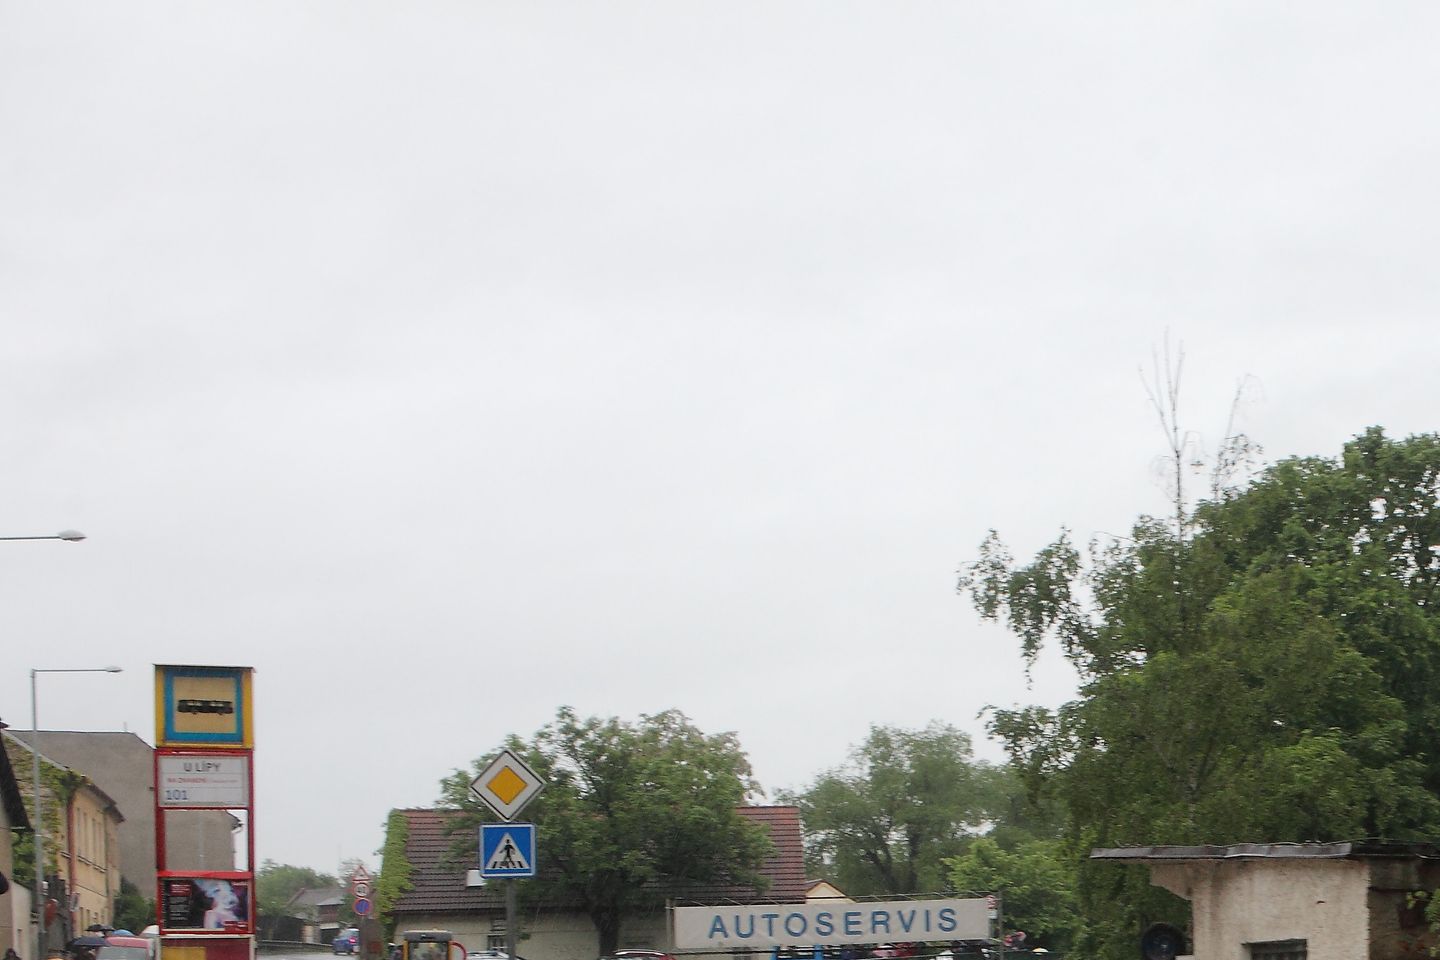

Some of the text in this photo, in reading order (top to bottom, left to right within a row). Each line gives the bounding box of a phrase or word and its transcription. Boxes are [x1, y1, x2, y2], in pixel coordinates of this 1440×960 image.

[183, 762, 193, 772] U
[165, 789, 188, 800] 101
[709, 908, 957, 939] AUTOSERVIS
